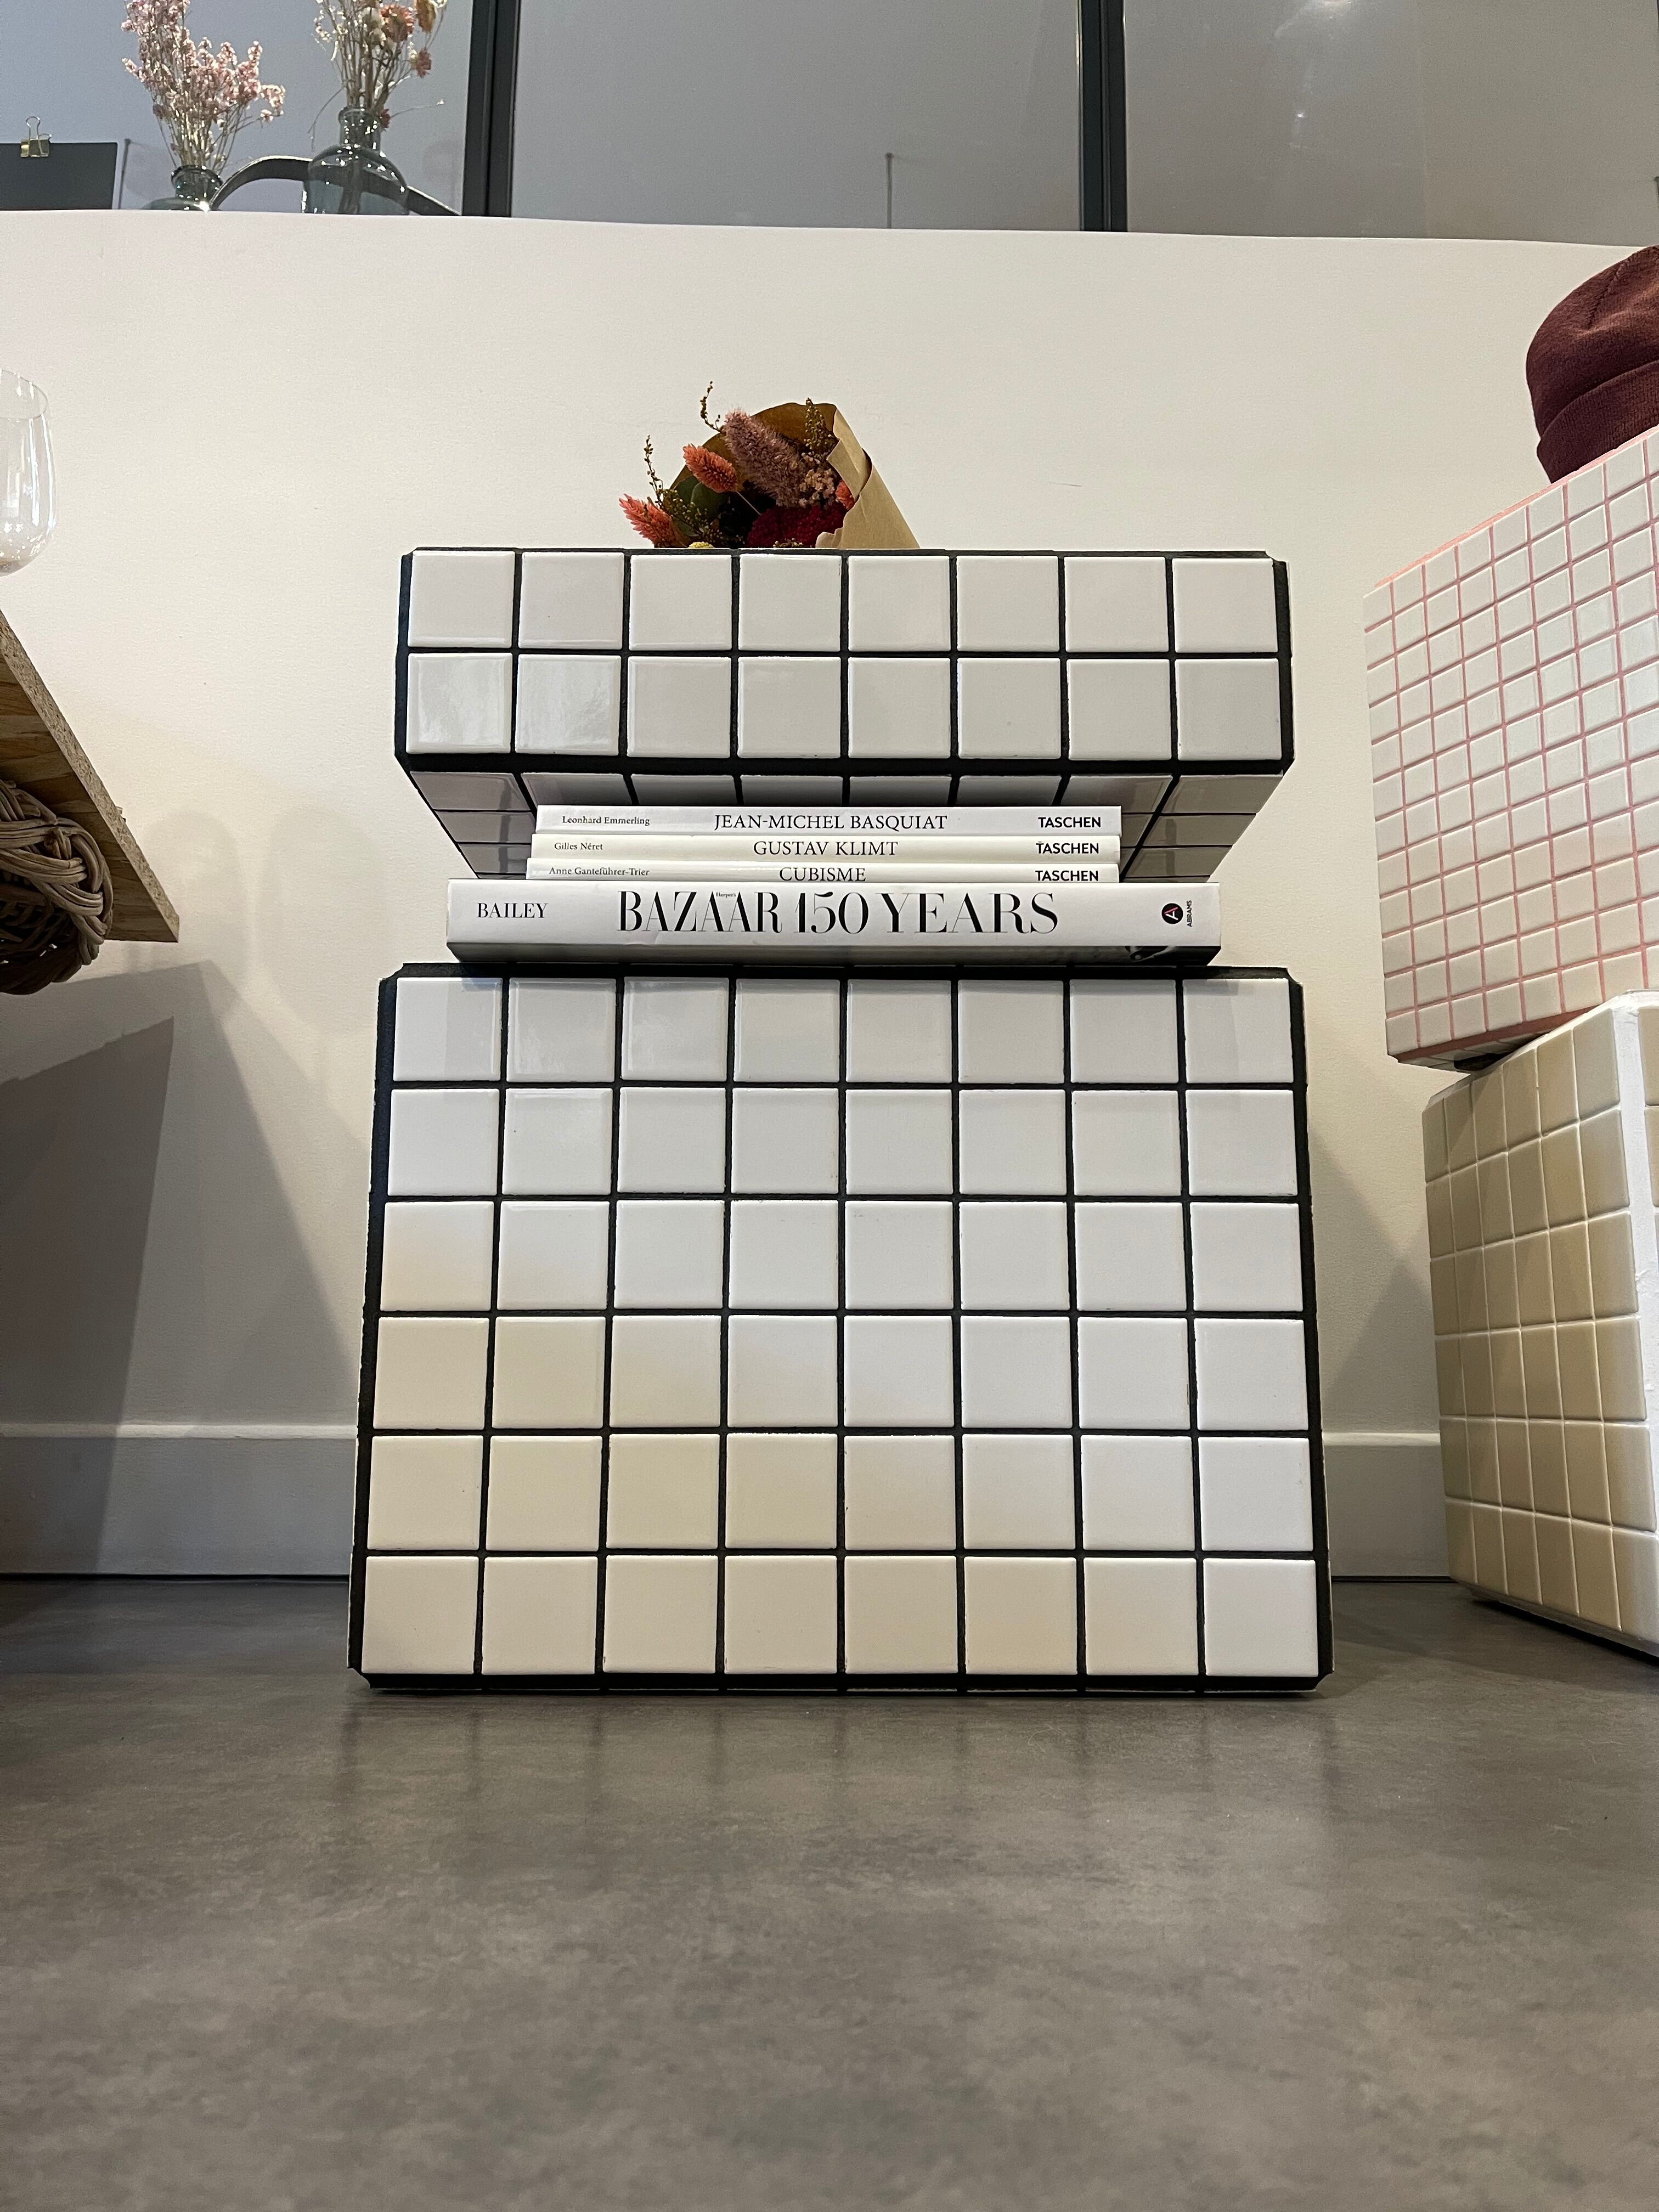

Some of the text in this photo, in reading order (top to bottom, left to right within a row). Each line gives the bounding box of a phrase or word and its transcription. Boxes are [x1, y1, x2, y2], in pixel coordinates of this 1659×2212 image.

[562, 816, 650, 826] Leonhard Emmerling
[714, 815, 947, 832] JEAN-MICHEL BASQUIAT
[1038, 817, 1101, 828] TASCHEN
[554, 842, 603, 850] Gilles Néret
[753, 841, 898, 855] GUSTAV KLIMT
[1036, 843, 1099, 854] TASCHEN
[549, 867, 572, 875] Anne
[779, 867, 866, 882] CUBISME
[1035, 870, 1098, 882] TASCHEN
[477, 902, 549, 918] BAILEY
[617, 890, 1058, 934] BAZAAR 150 YEARS
